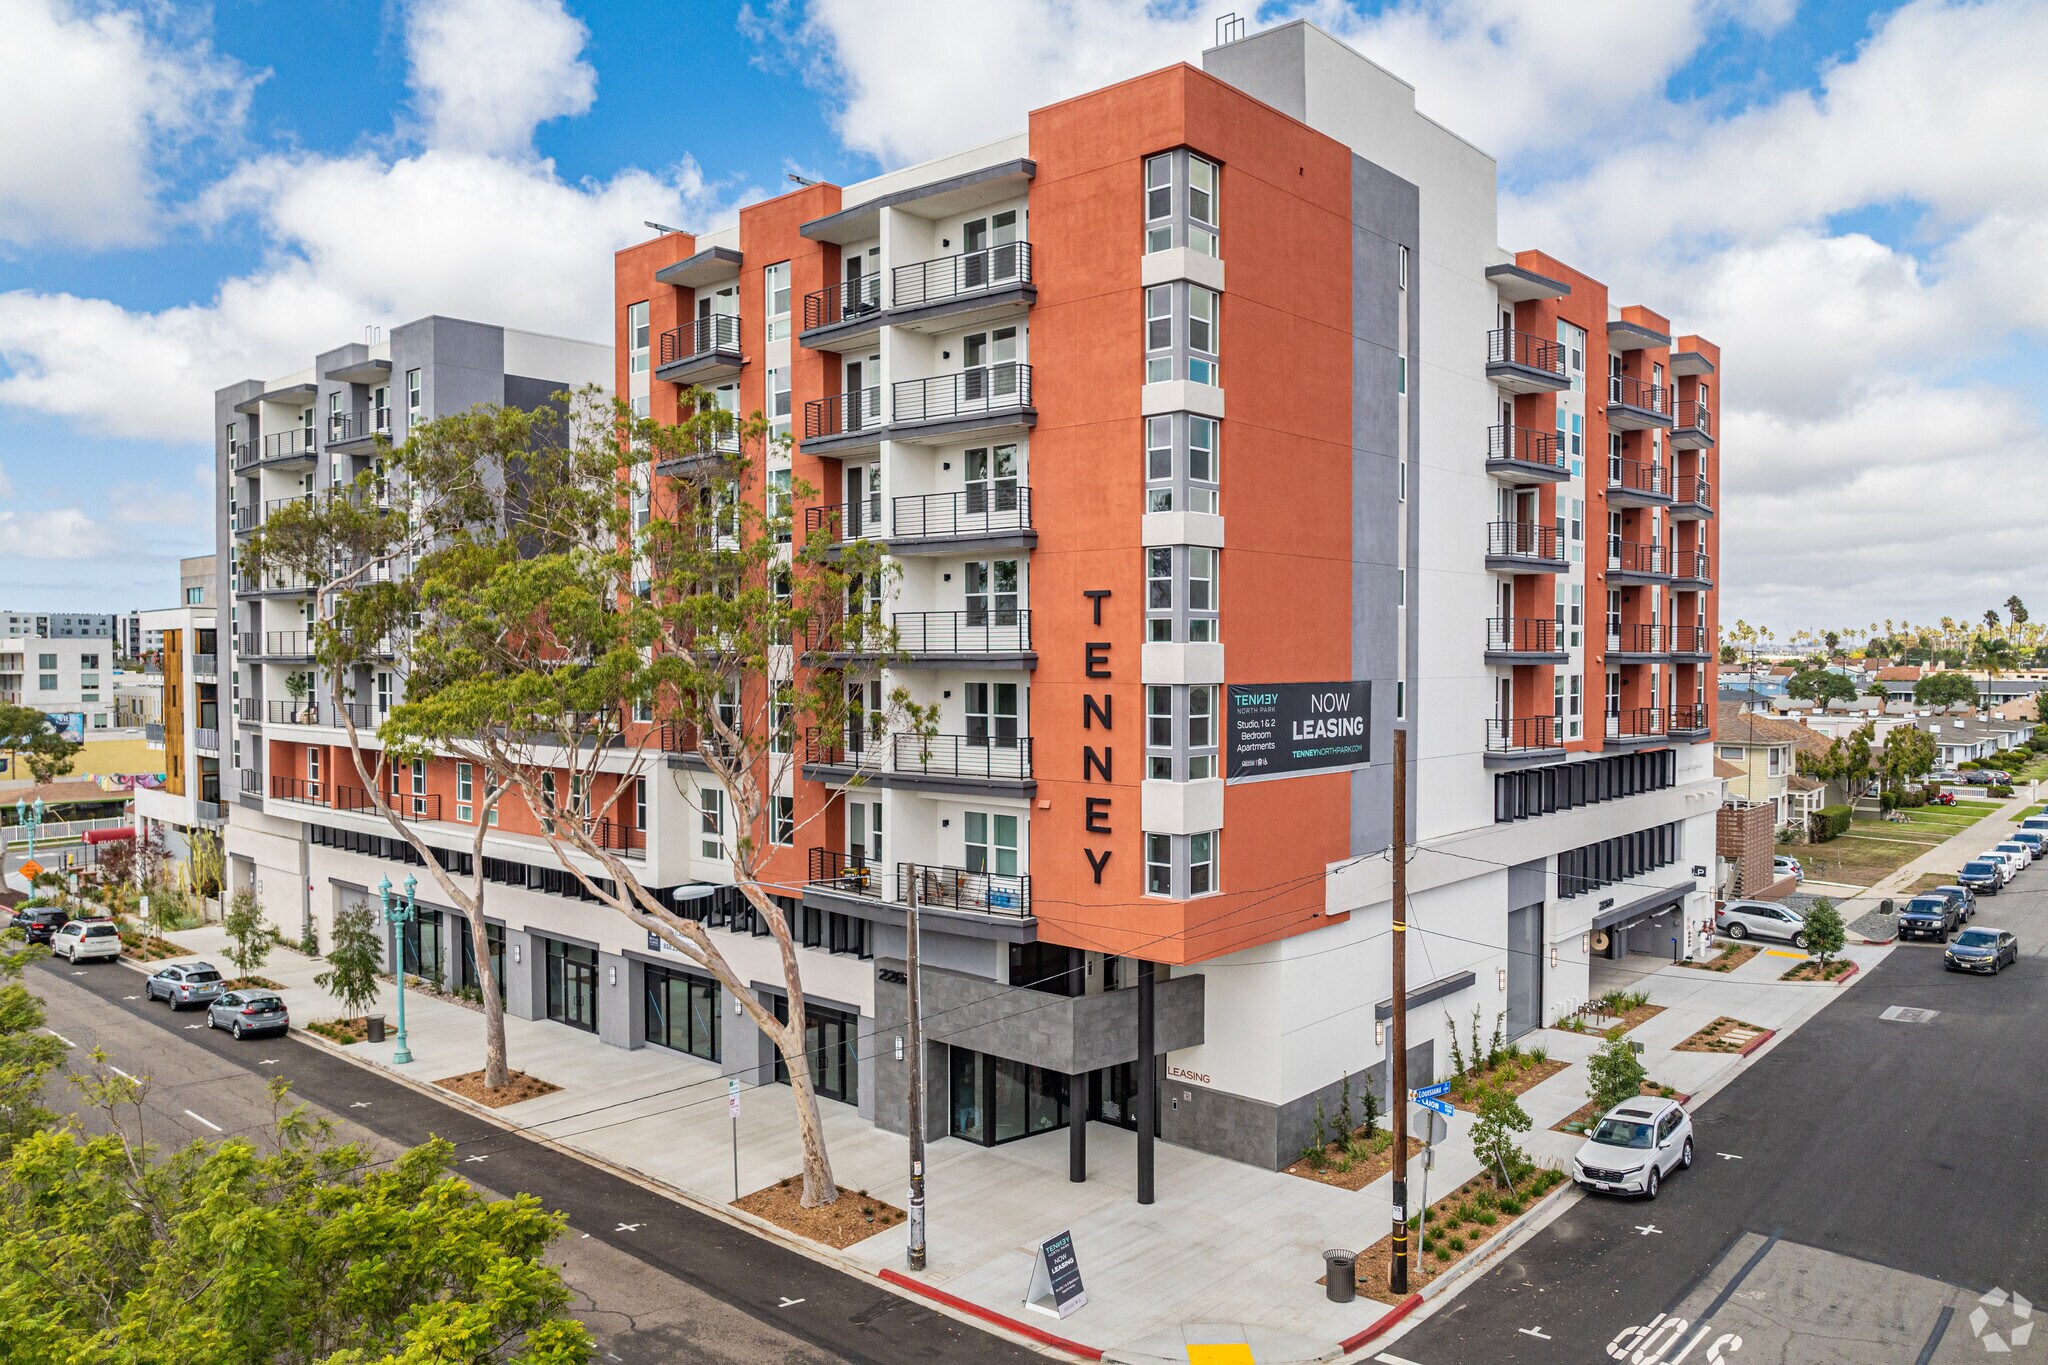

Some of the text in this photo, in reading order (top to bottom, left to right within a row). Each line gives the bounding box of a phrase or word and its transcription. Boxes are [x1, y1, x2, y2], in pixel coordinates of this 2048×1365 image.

[1311, 693, 1350, 713] NOW
[1237, 720, 1259, 729] Studio,
[1265, 719, 1270, 727] &
[1271, 719, 1276, 727] 2
[1292, 717, 1364, 740] LEASING
[1083, 589, 1112, 885] TENNEY
[1241, 732, 1272, 740] Bedroom
[1237, 743, 1276, 753] Apartments
[1168, 1066, 1211, 1084] LEASING
[1051, 1257, 1074, 1274] LEASING
[1054, 1253, 1067, 1265] NOW
